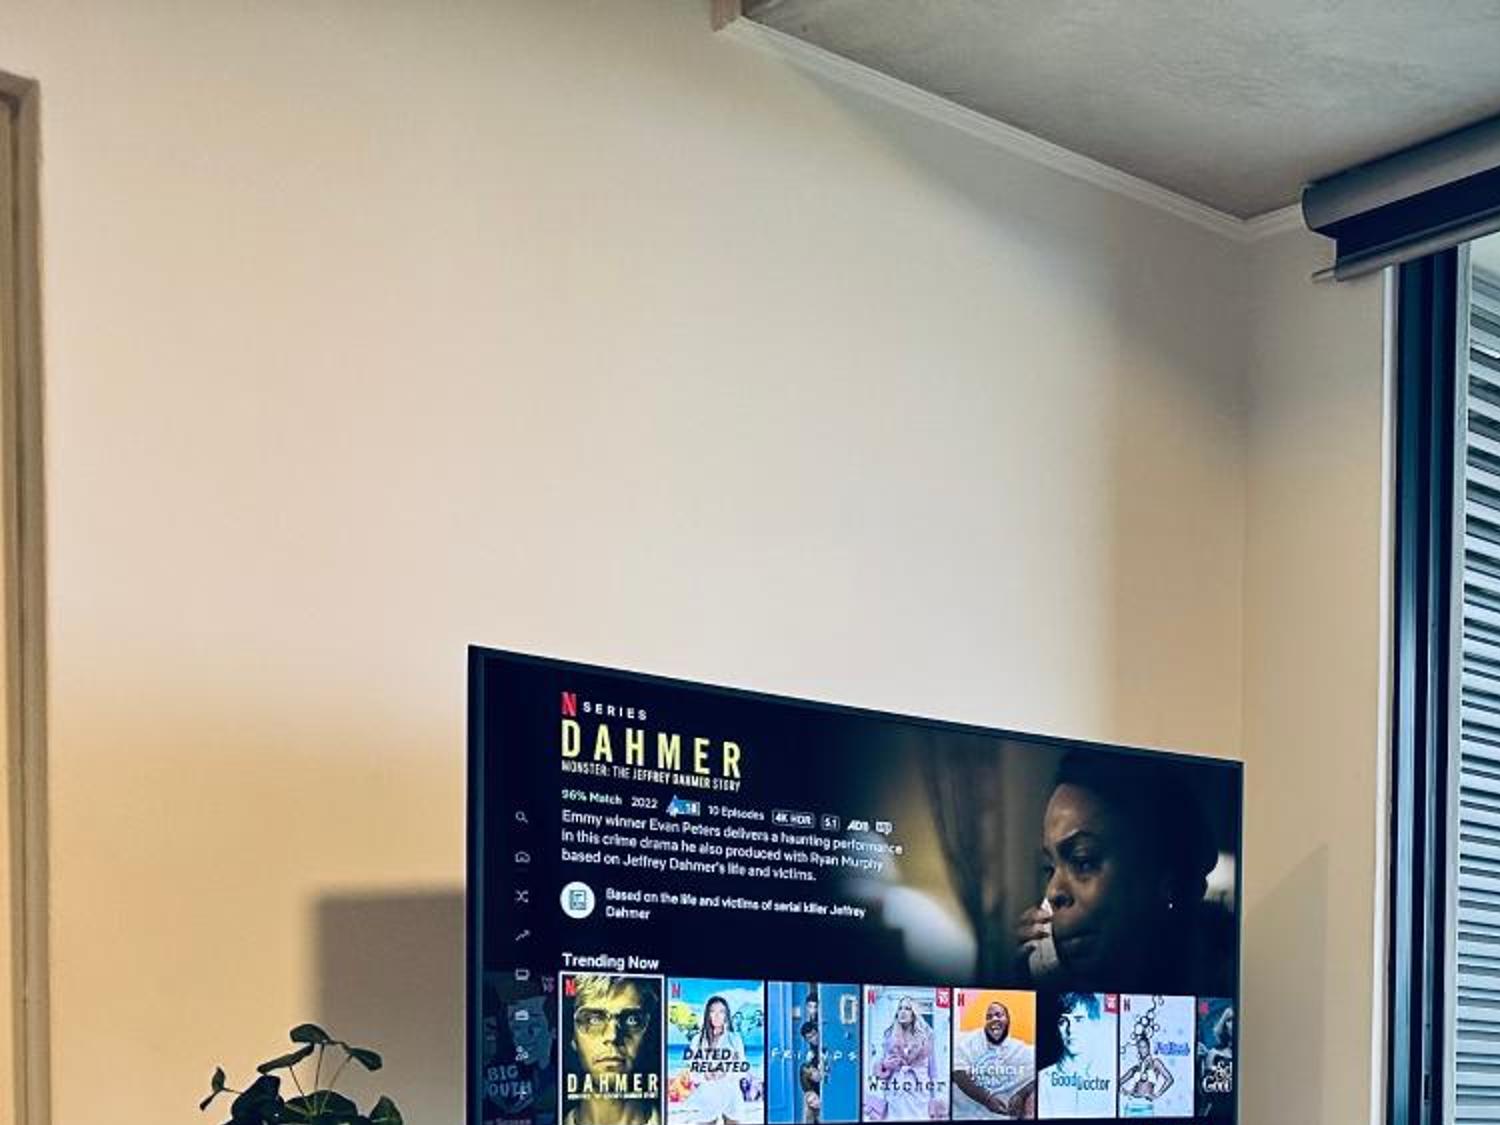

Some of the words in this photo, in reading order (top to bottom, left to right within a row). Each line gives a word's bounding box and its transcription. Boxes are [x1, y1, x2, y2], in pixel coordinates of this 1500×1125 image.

[583, 701, 647, 721] SERIES
[561, 719, 741, 778] DAHMER
[561, 760, 610, 777] MONSTER:
[612, 765, 630, 779] THE
[633, 768, 670, 785] JEFFREY
[672, 773, 710, 788] DAHMER
[712, 777, 740, 793] STORY
[589, 791, 623, 805] Match
[631, 796, 658, 809] 2022
[721, 805, 764, 821] Episodes
[562, 809, 602, 827] Emmy
[605, 814, 647, 830] winner
[649, 818, 680, 832] Evan
[682, 822, 720, 837] Peters
[723, 826, 768, 842] delivers
[771, 833, 778, 843] a
[781, 831, 830, 851] haunting
[833, 839, 903, 855] performance
[577, 829, 600, 845] this
[602, 834, 637, 848] crime
[640, 836, 679, 852] drama
[681, 840, 697, 852] he
[699, 841, 723, 855] also
[726, 845, 781, 862] produced
[784, 850, 808, 862] with
[810, 853, 838, 868] Ryan
[842, 855, 883, 873] Murphy
[562, 848, 600, 863] based
[604, 855, 620, 865] on
[623, 854, 667, 871] Jeffrey
[669, 857, 725, 874] Dahmer's
[728, 862, 745, 876] life
[748, 865, 770, 878] and
[772, 867, 816, 882] victims.
[606, 887, 641, 902] Based
[643, 894, 659, 904] on
[660, 892, 678, 905] the
[680, 894, 697, 906] life
[699, 896, 720, 907] and
[722, 896, 759, 910] victims
[762, 900, 773, 911] of
[774, 901, 801, 913] serial
[803, 902, 828, 915] killer
[830, 904, 866, 919] Jeffrey
[606, 905, 650, 920] Dahmer
[562, 953, 625, 971] Trending
[628, 956, 659, 969] Now
[683, 1048, 731, 1061] DATED
[488, 1065, 519, 1080] BIG
[689, 1061, 751, 1074] RELATED
[567, 1073, 658, 1094] DAHMER
[868, 1076, 946, 1092] Watcher
